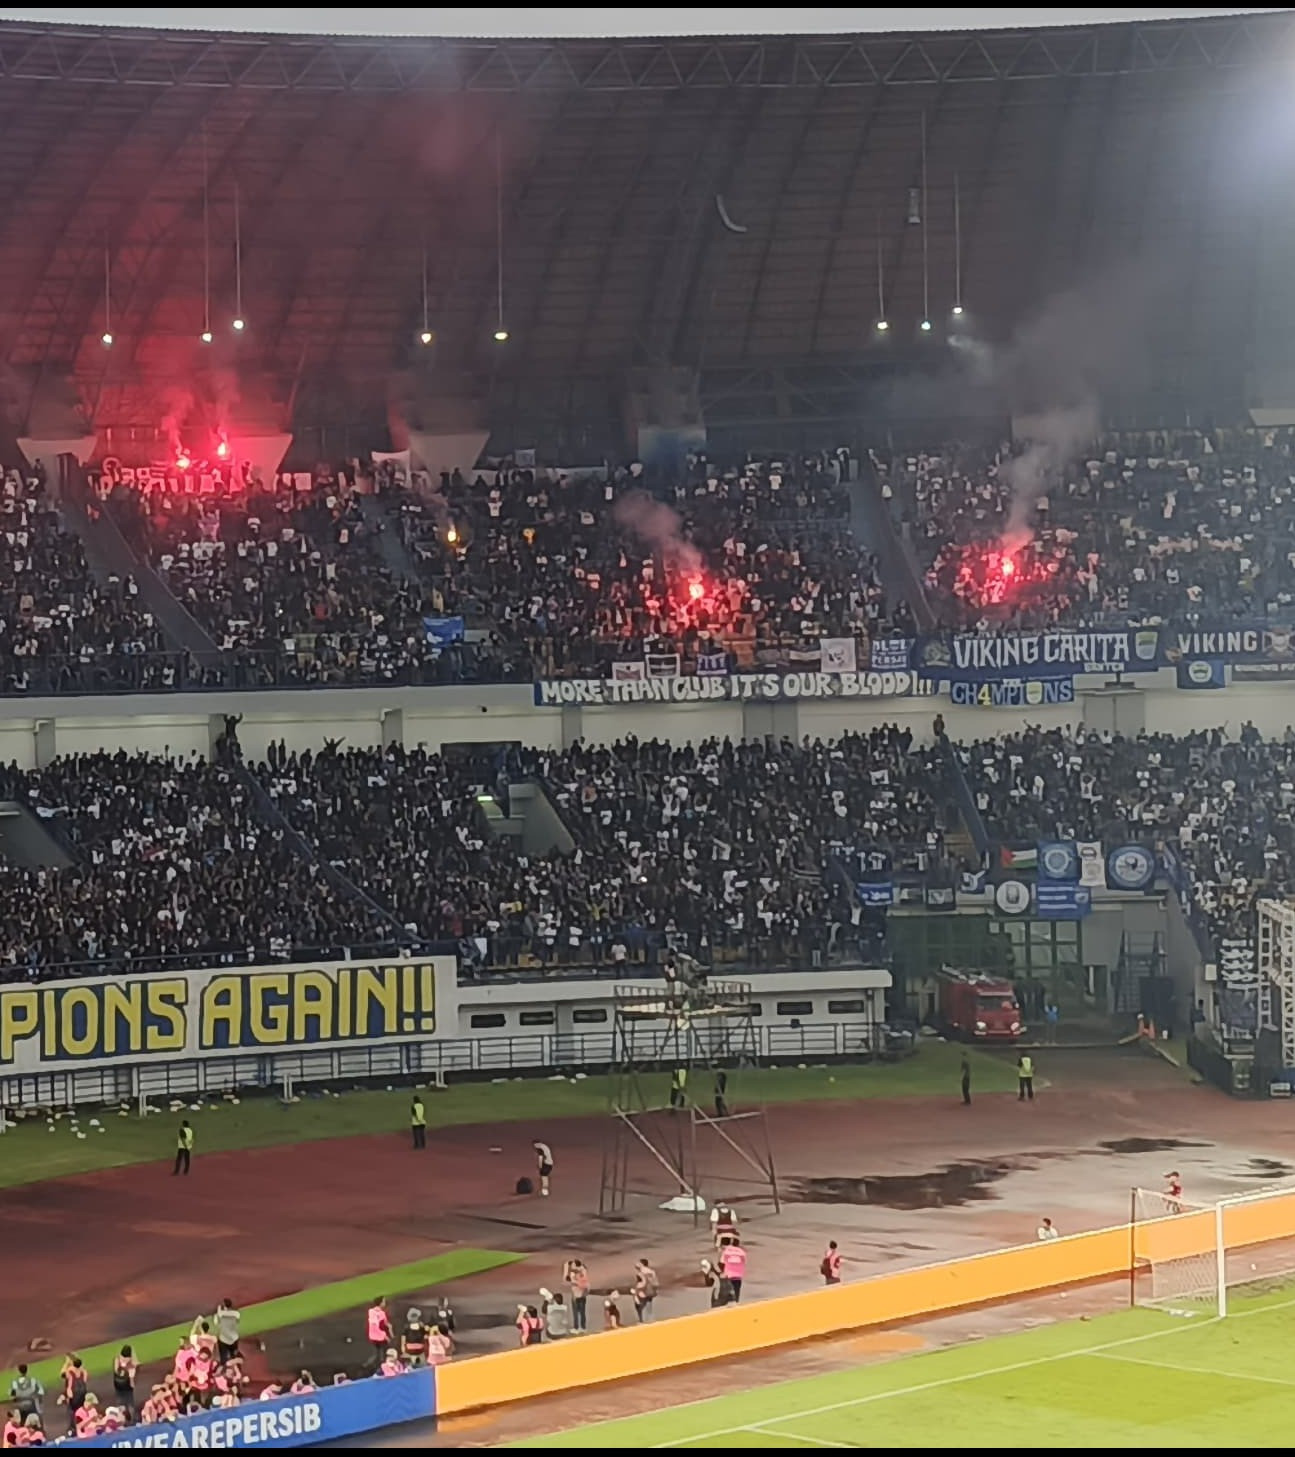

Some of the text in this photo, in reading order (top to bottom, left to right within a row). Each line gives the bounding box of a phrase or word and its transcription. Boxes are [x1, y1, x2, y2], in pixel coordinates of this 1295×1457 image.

[953, 633, 1130, 669] VIKING CARITA
[1178, 630, 1258, 654] VIKING
[540, 679, 604, 703] MORE
[606, 677, 670, 702] THAN
[672, 676, 725, 700] CLUB
[730, 673, 780, 698] IT'S
[783, 672, 833, 698] OUR
[201, 963, 435, 1049] AGAIN!!
